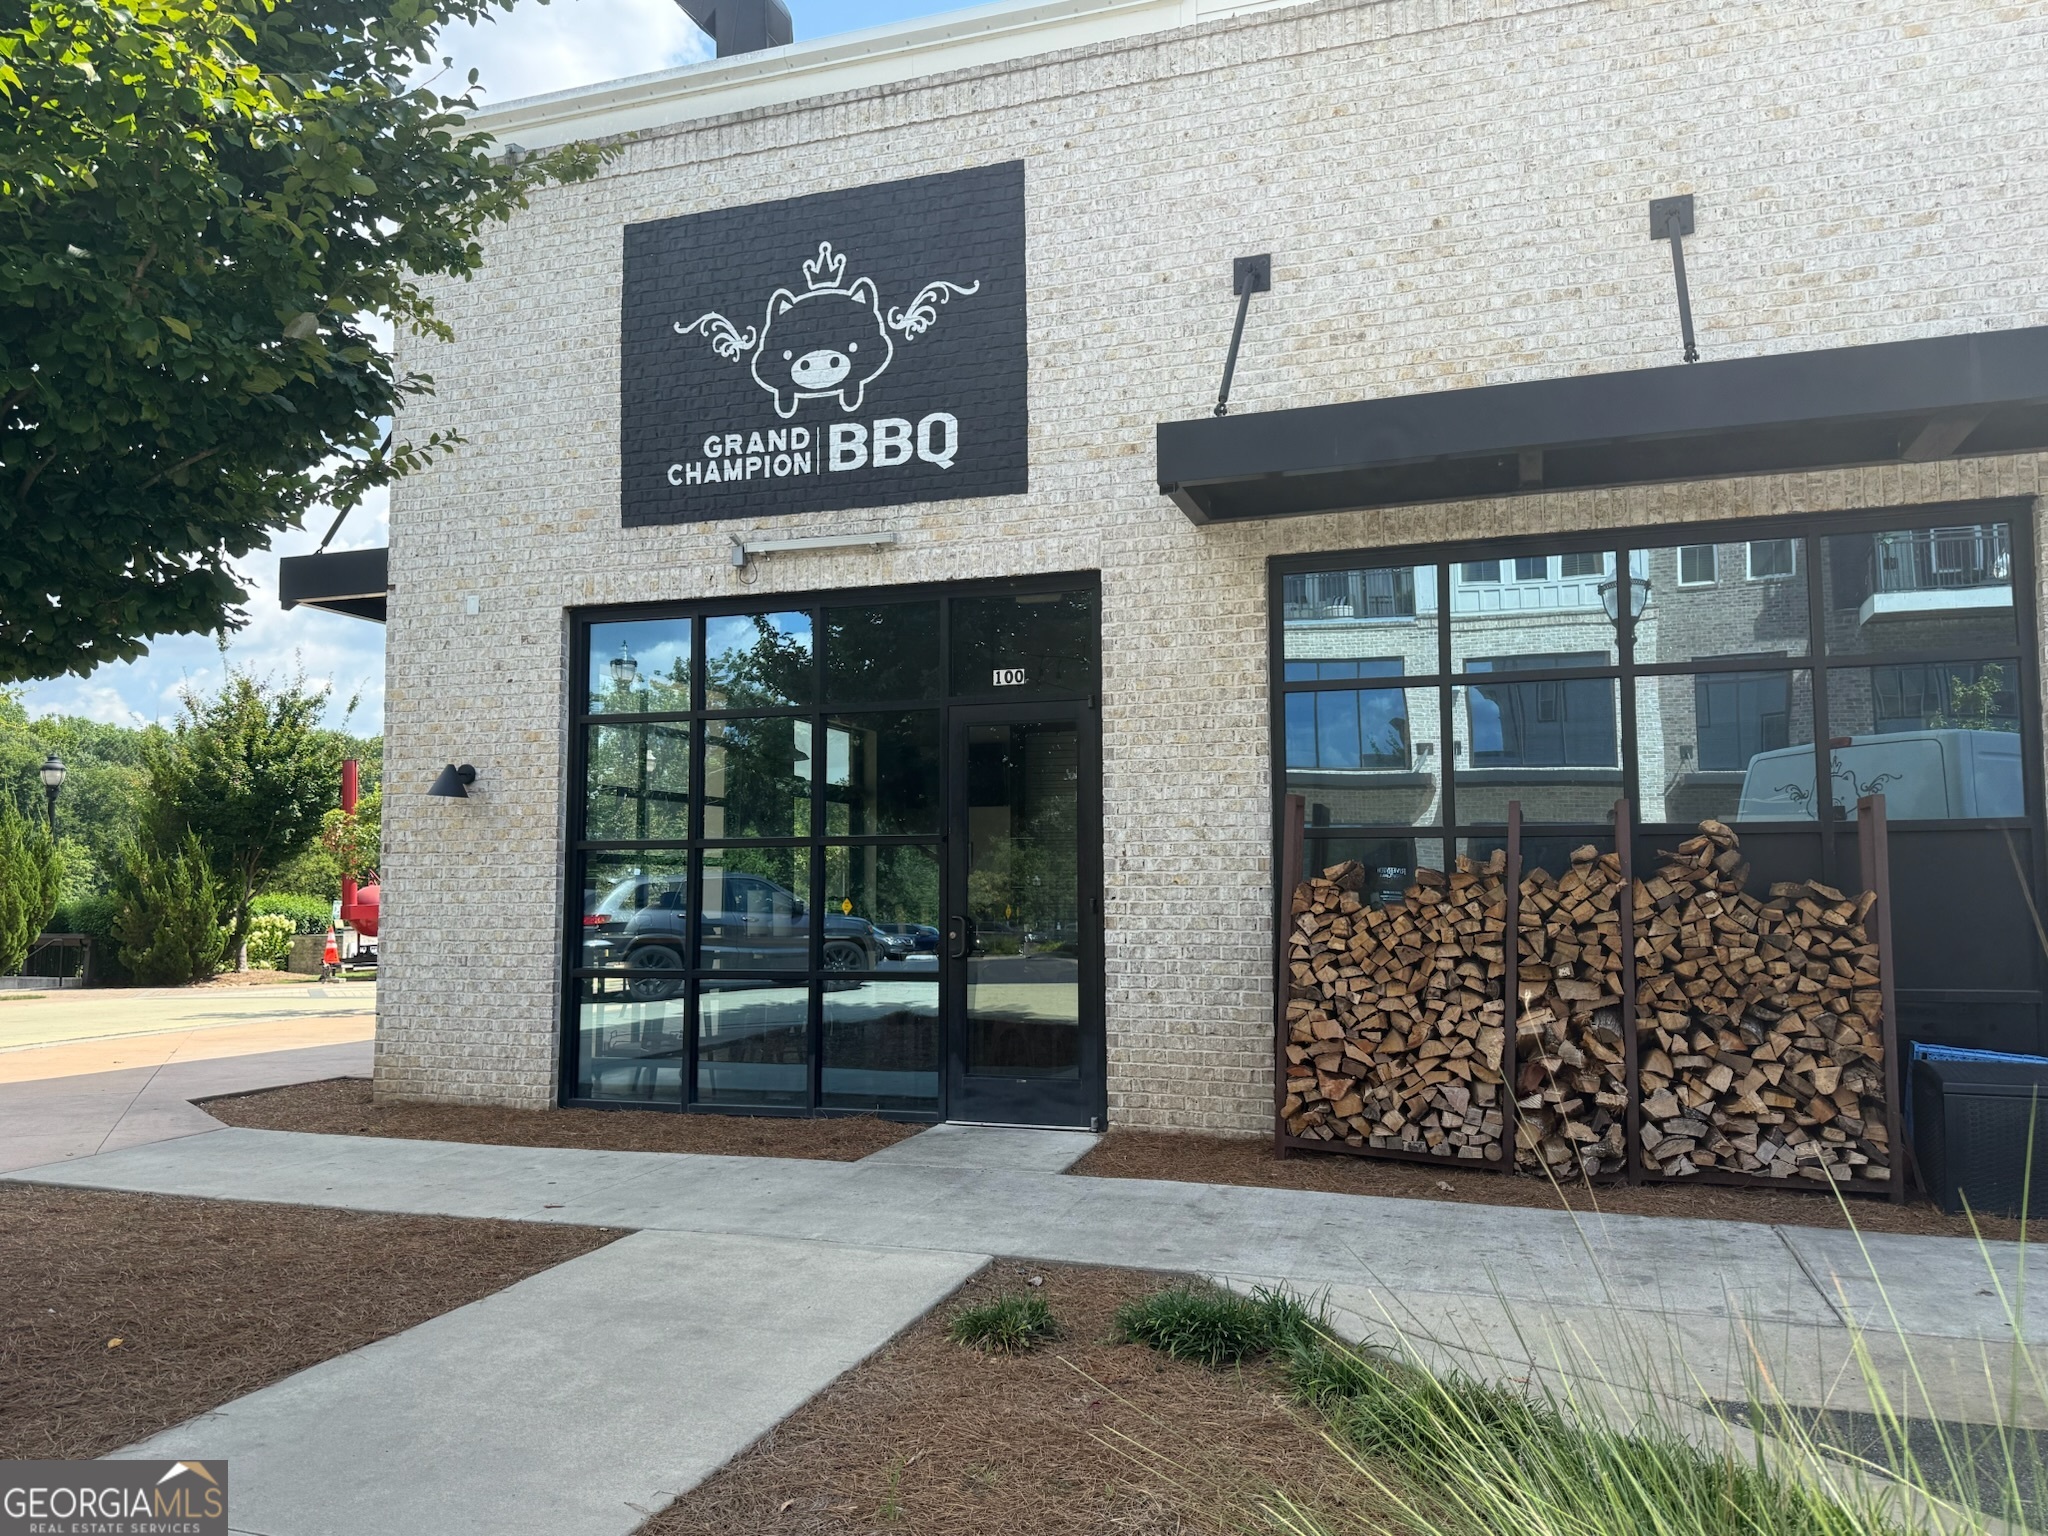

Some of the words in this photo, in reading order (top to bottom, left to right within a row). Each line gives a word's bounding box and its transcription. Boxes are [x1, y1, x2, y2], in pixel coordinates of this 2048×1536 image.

[704, 427, 810, 458] GRAND
[829, 412, 958, 470] BBQ
[667, 452, 811, 486] CHAMPION
[996, 670, 1024, 684] 100
